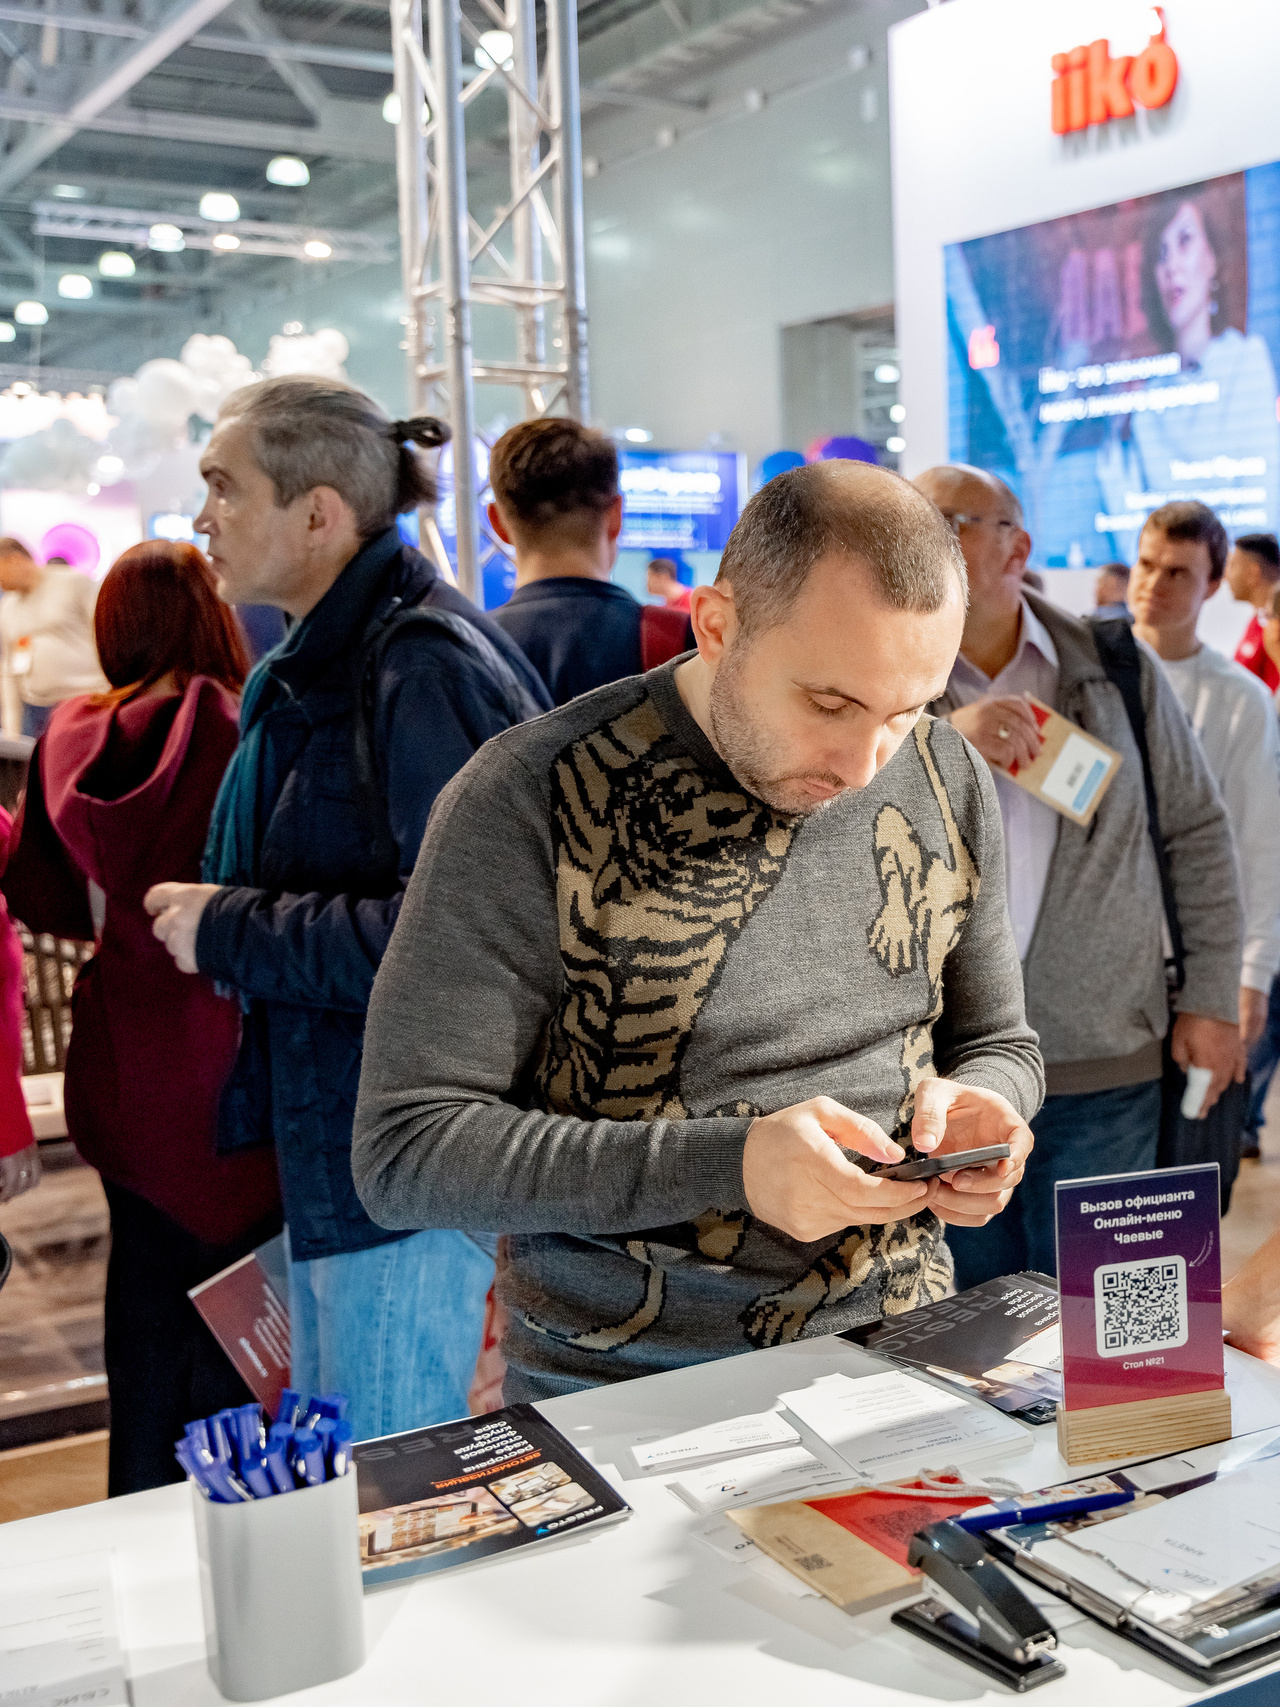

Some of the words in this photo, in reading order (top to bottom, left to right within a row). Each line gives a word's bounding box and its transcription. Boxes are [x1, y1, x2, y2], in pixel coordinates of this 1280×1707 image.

[1051, 8, 1178, 134] iiko
[1080, 1199, 1123, 1214] Вызов
[1125, 1190, 1195, 1210] официанта
[1094, 1209, 1183, 1230] Онлайн-меню
[1114, 1229, 1164, 1244] Чаевые
[1123, 1360, 1144, 1370] Стол
[1145, 1356, 1165, 1367] №21
[473, 1425, 512, 1441] клуба
[474, 1420, 507, 1434] бара
[453, 1430, 517, 1455] фастфуда
[460, 1435, 522, 1461] столовой
[495, 1439, 528, 1455] кафе
[656, 1446, 699, 1456] PRESTO
[462, 1443, 534, 1474] ресторана
[434, 1451, 542, 1489] автоматизация
[548, 1505, 604, 1530] PRESTO
[1164, 1537, 1205, 1556] АНКЕТА
[1175, 1568, 1217, 1587] СБИС
